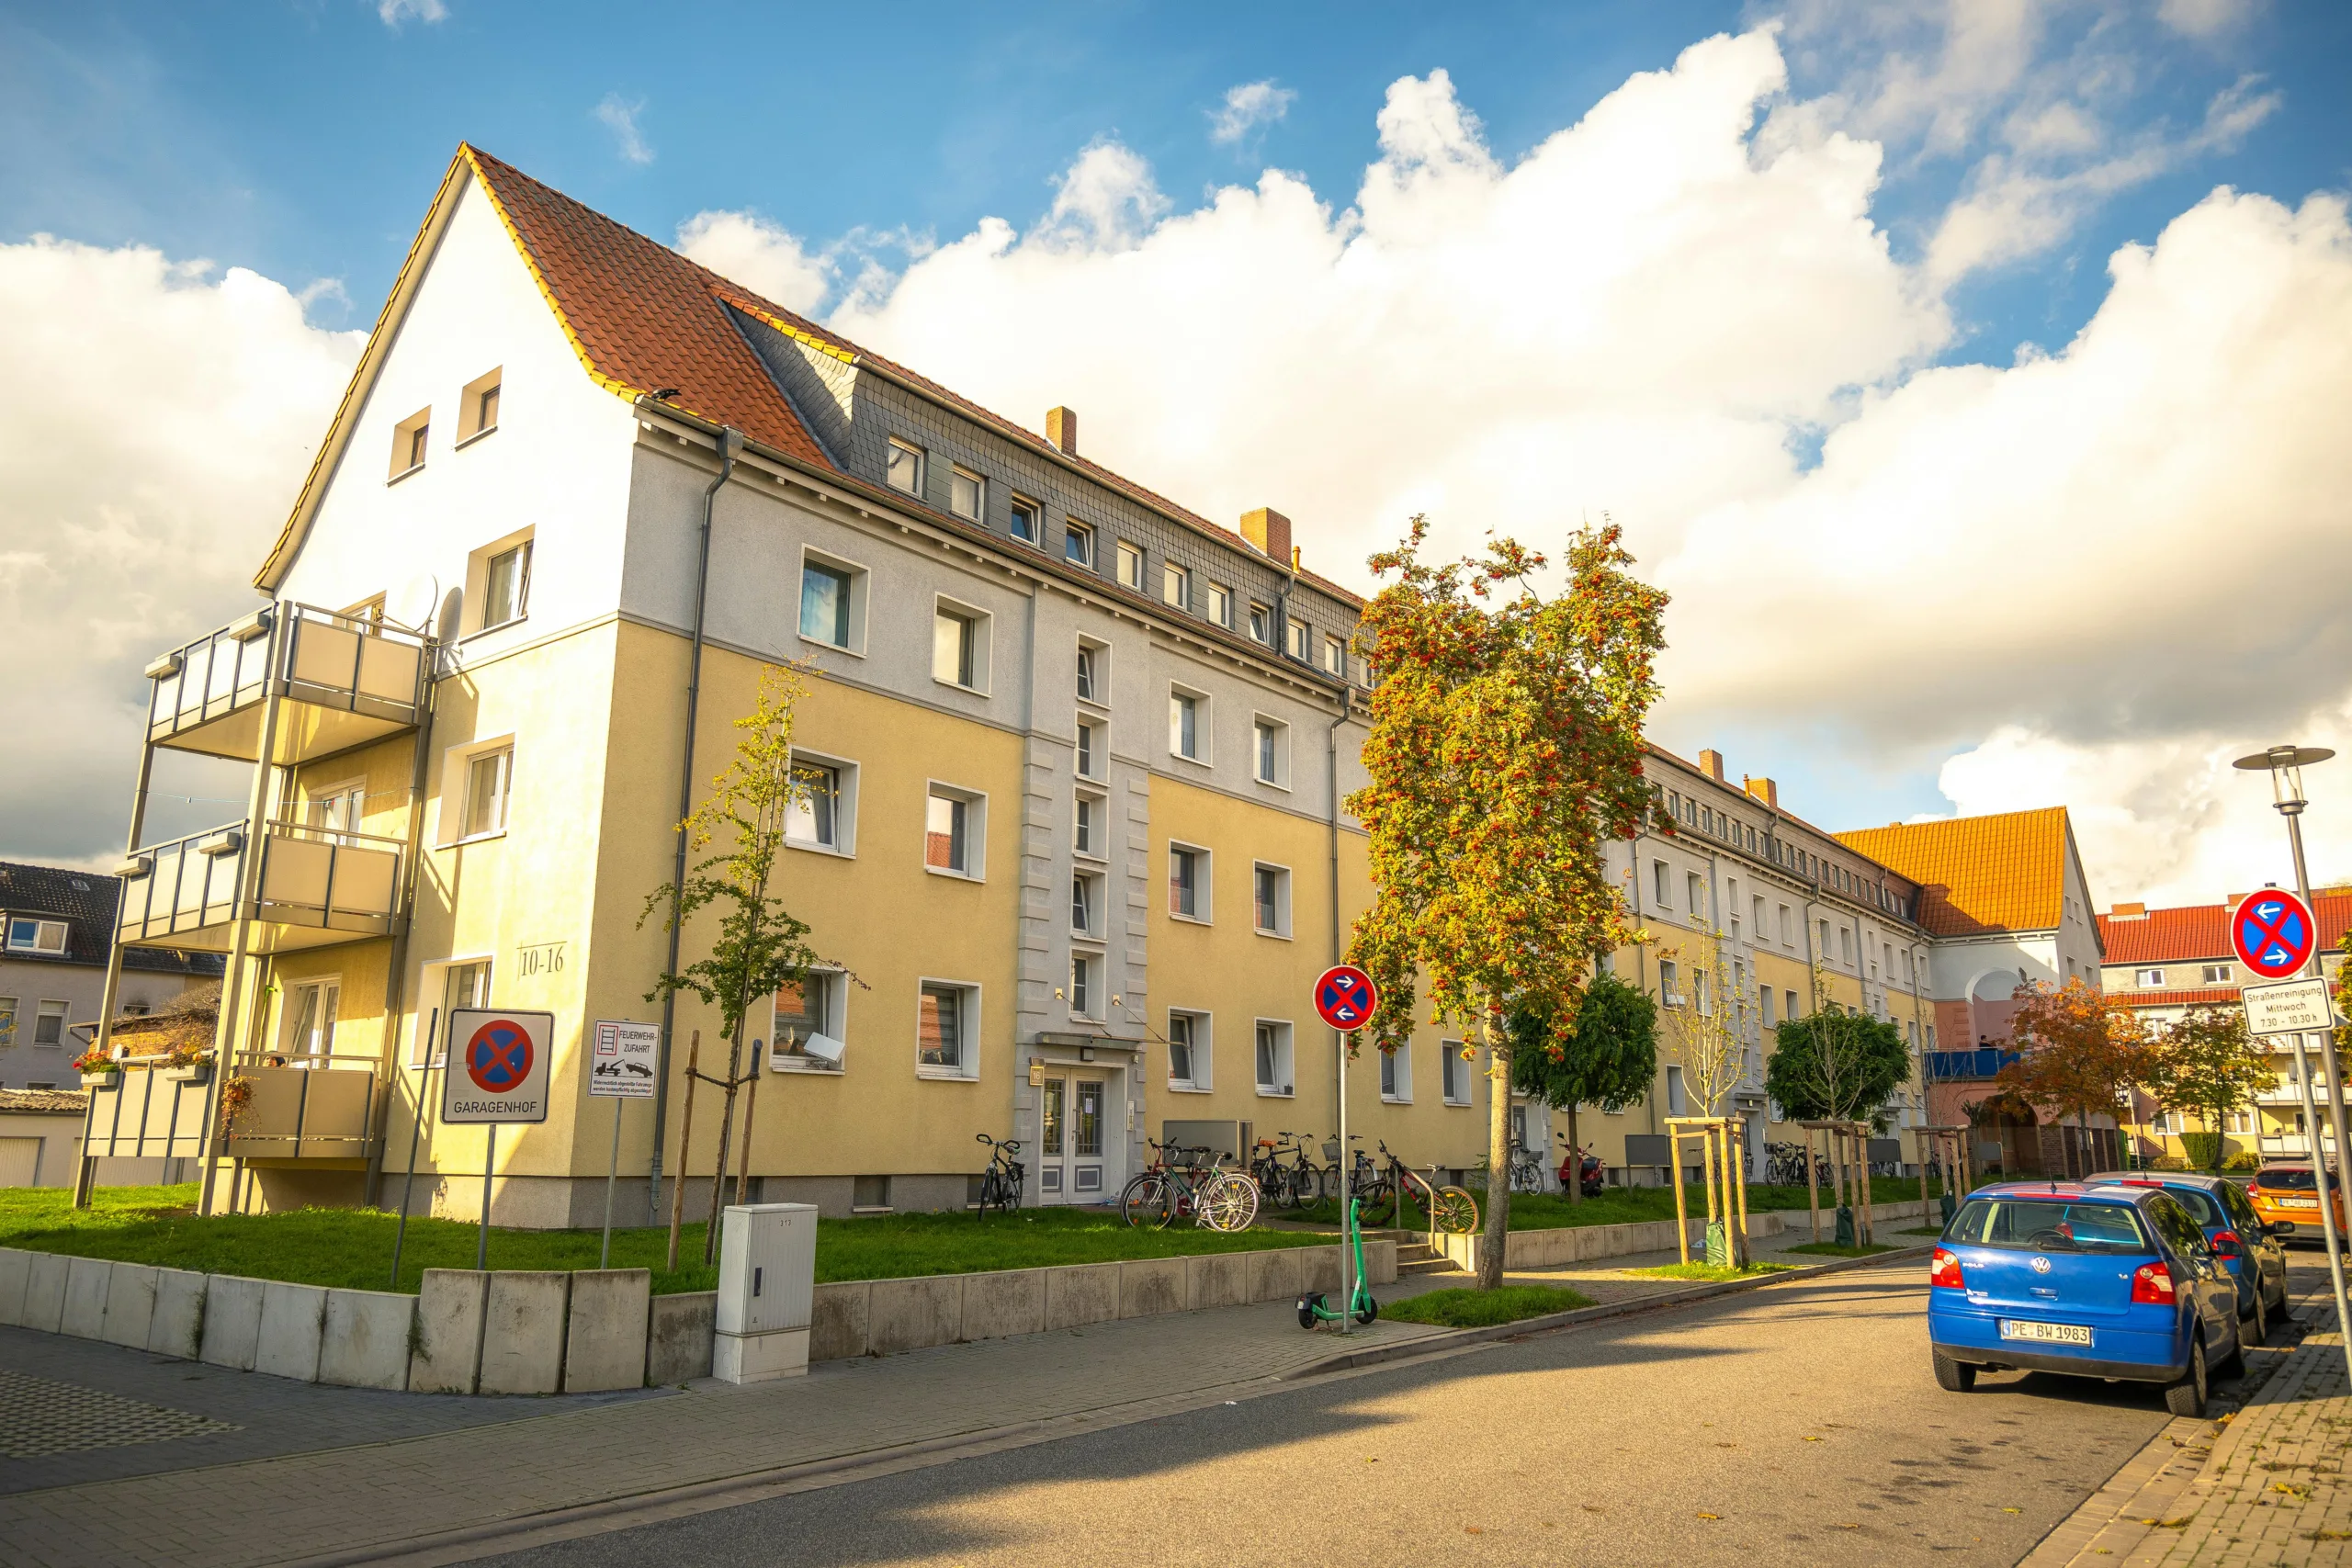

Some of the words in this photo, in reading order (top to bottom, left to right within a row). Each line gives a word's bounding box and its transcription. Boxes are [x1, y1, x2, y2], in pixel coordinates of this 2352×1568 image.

[521, 944, 564, 976] 10-16
[2246, 987, 2323, 1003] Straßenreinigung
[2266, 1001, 2307, 1013] Mittwoch
[2260, 1017, 2277, 1028] 7.30
[2289, 1014, 2311, 1025] 10.30
[2312, 1013, 2318, 1022] h
[618, 1031, 657, 1041] FEUERWEHR-
[624, 1044, 650, 1054] ZUFAHRT
[1033, 1071, 1041, 1080] 16
[454, 1100, 537, 1113] GARAGENHOF
[780, 1219, 792, 1227] 313
[2011, 1322, 2028, 1337] PE
[2036, 1325, 2052, 1338] BW
[2055, 1325, 2088, 1342] 1983
